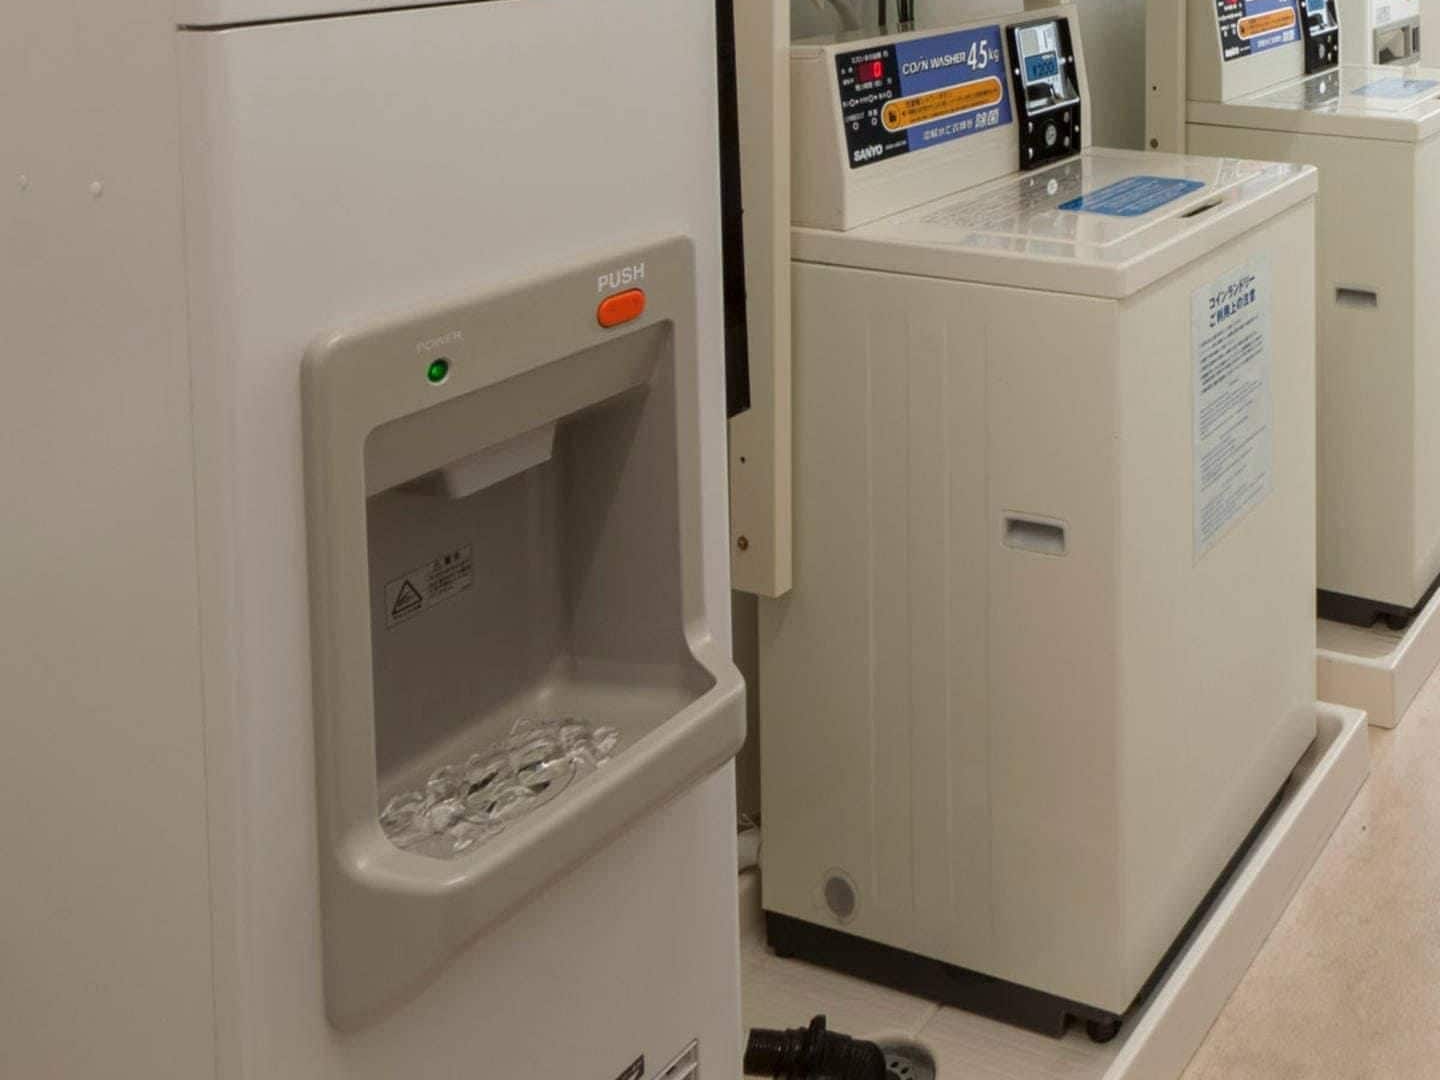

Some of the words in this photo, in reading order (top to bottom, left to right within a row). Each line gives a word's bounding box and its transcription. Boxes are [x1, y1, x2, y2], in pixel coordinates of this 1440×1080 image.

[930, 50, 967, 69] WASHER
[853, 143, 884, 163] SANYO
[597, 262, 646, 293] PUSH
[416, 329, 465, 355] POWER
